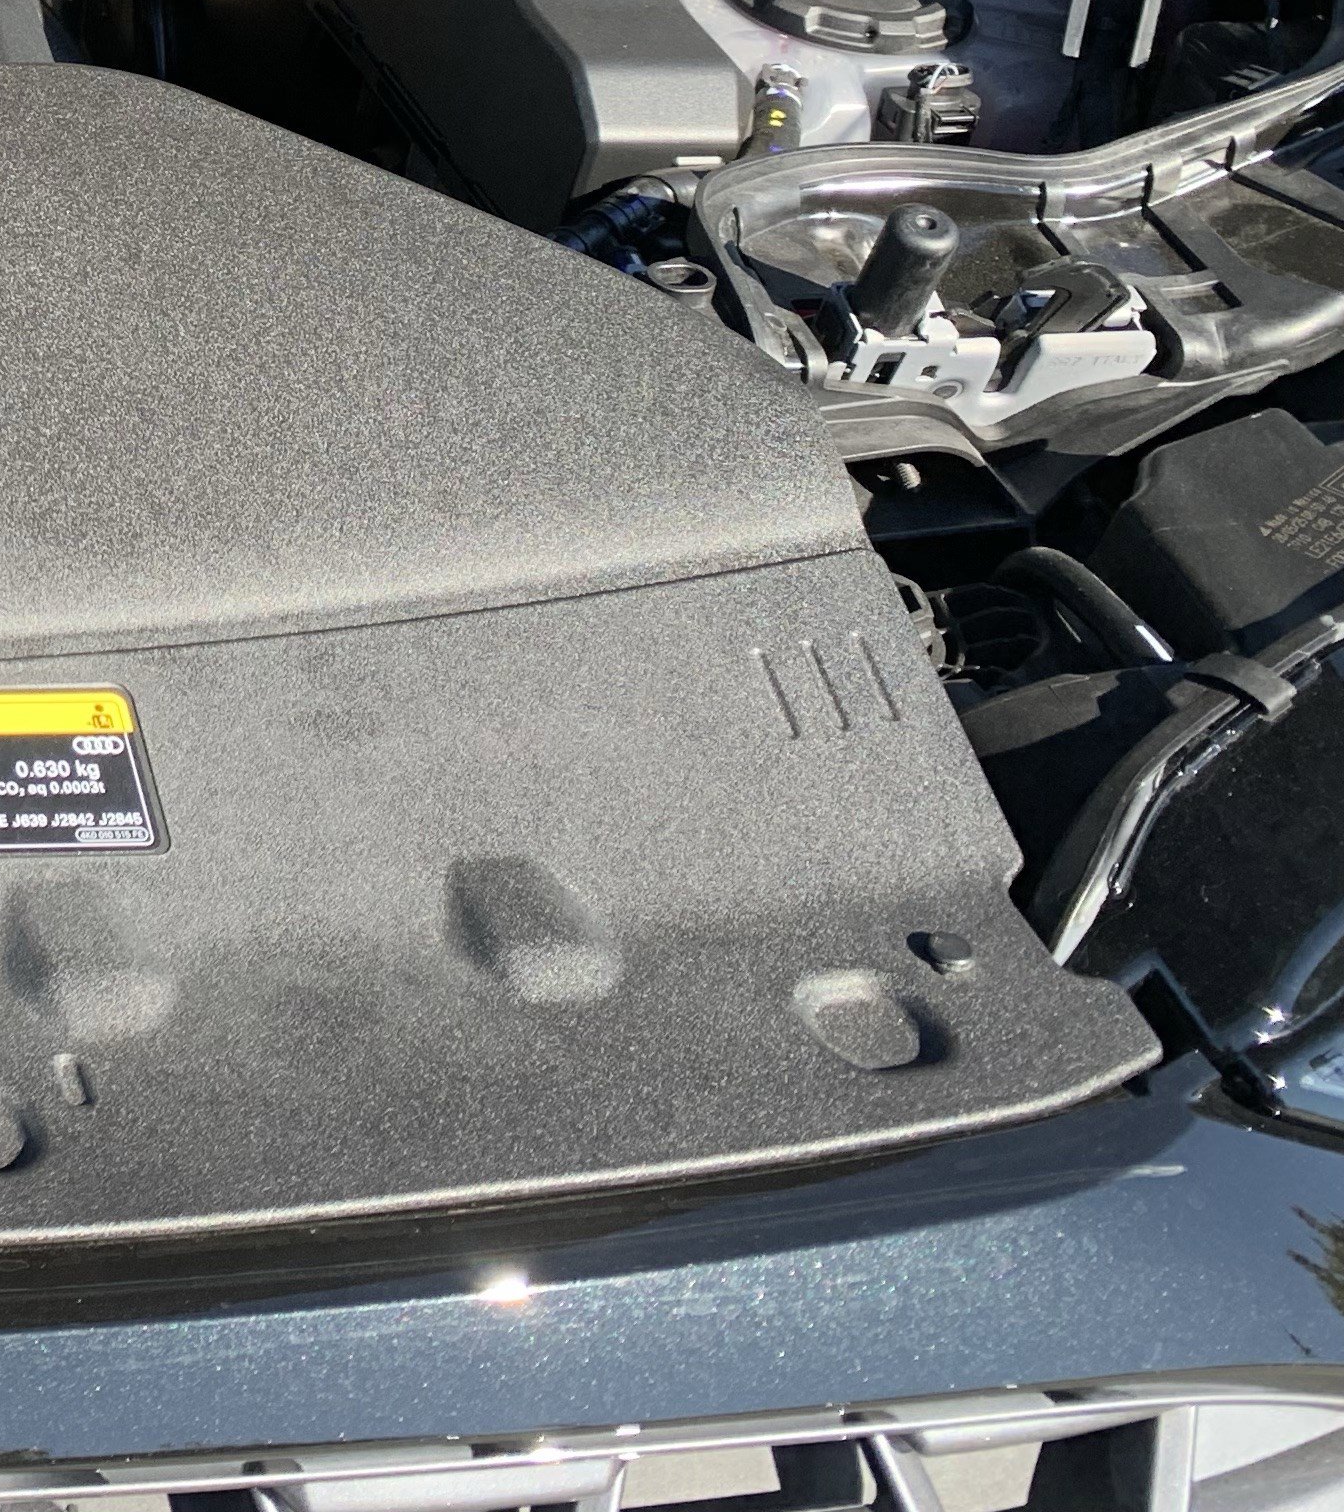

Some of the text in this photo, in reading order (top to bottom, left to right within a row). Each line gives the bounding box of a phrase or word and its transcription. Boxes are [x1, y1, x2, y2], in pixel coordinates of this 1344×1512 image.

[14, 759, 101, 780] 0.630 kg
[27, 783, 47, 797] eq
[50, 781, 107, 795] 0.0003t
[12, 813, 47, 828] J639
[51, 812, 95, 827] J2842
[99, 812, 143, 826] J2845
